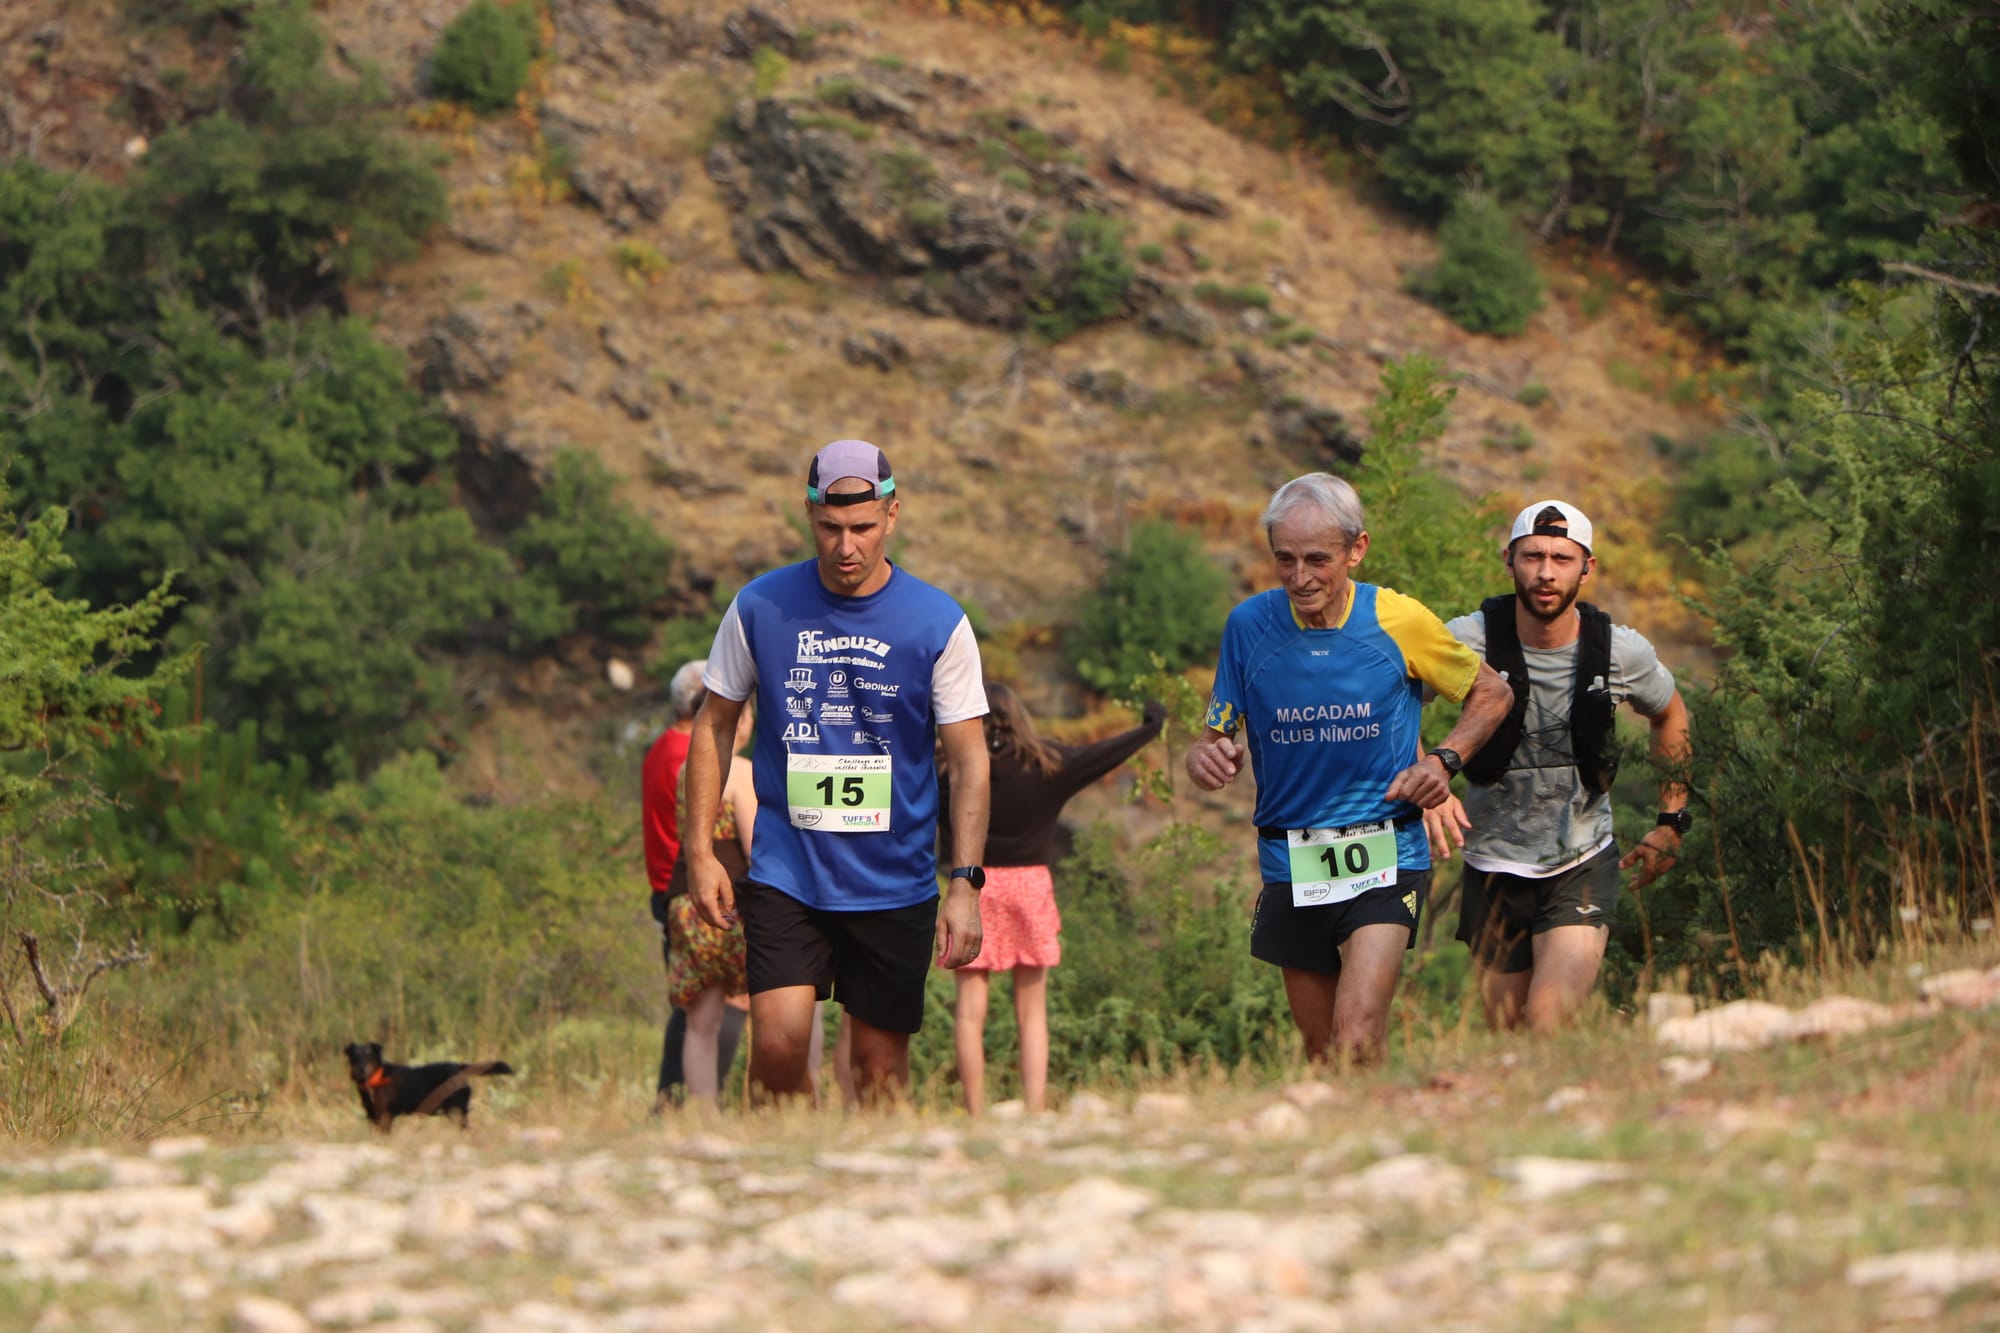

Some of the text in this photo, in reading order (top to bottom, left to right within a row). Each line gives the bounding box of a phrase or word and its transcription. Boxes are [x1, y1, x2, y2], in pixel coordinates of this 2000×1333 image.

[1276, 702, 1371, 722] MACADAM
[1270, 723, 1380, 744] CLUB NÎMOIS
[816, 775, 865, 807] 15
[1320, 842, 1370, 878] 10
[1303, 888, 1328, 897] BFP
